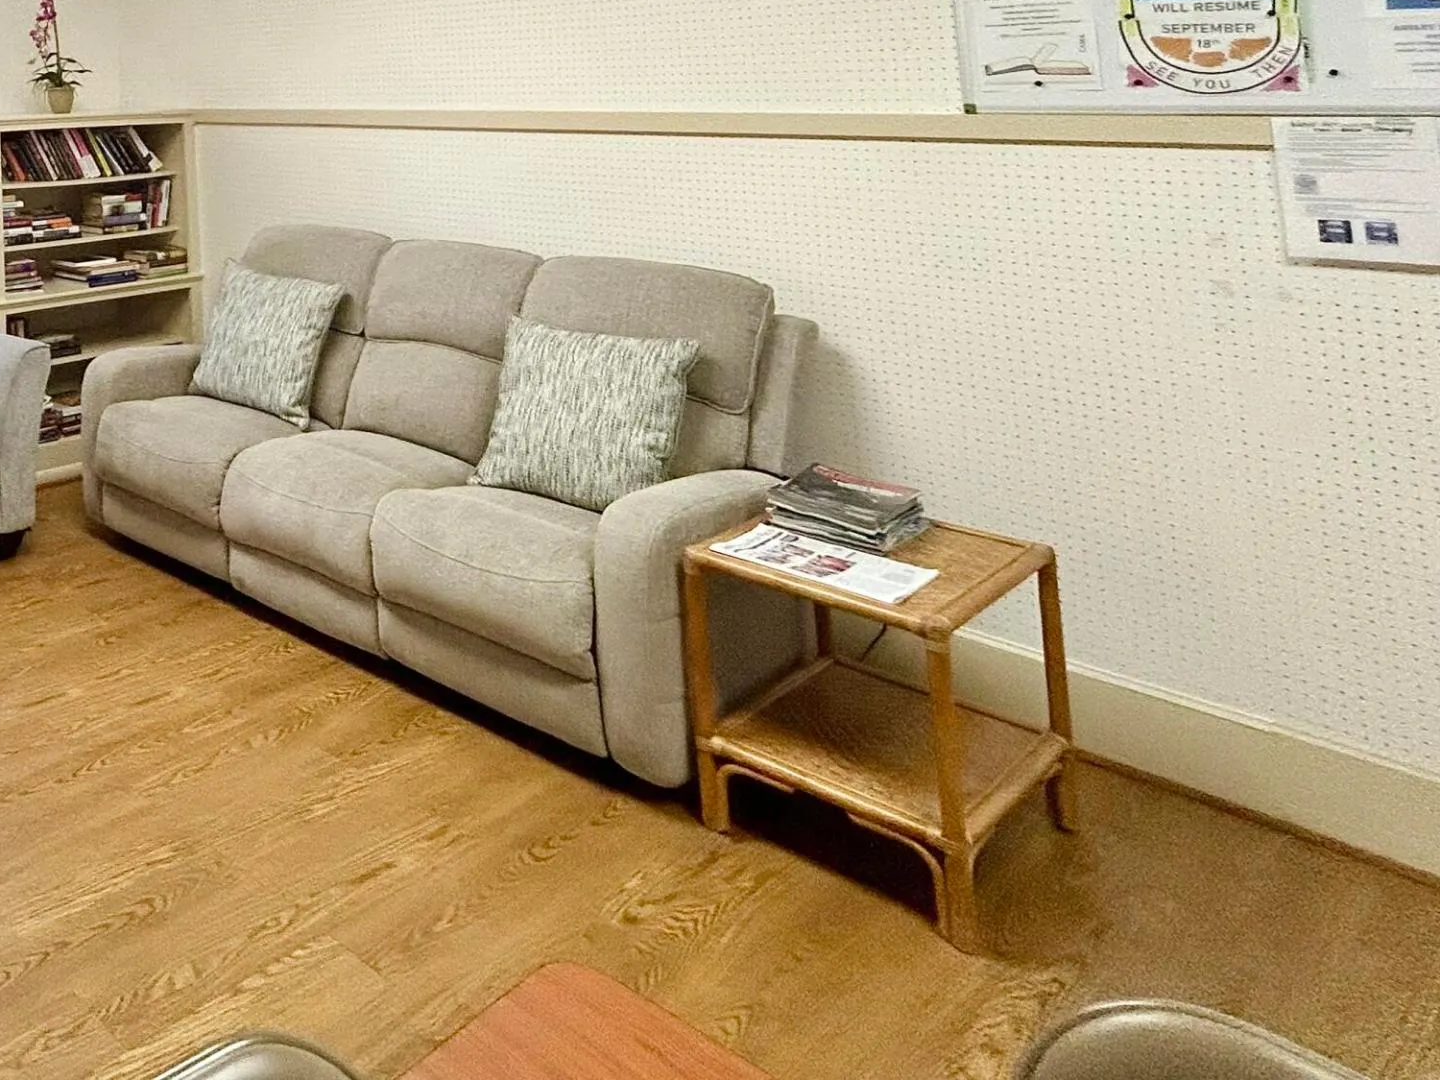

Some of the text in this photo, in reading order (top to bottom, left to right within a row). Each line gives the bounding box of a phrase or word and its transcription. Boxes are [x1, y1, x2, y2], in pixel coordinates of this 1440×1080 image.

[1152, 0, 1261, 13] WILL RESUME
[1161, 23, 1257, 34] SEPTEMBER
[1145, 61, 1181, 82] SEE
[1193, 77, 1232, 90] YOU
[1251, 45, 1294, 79] THEN
